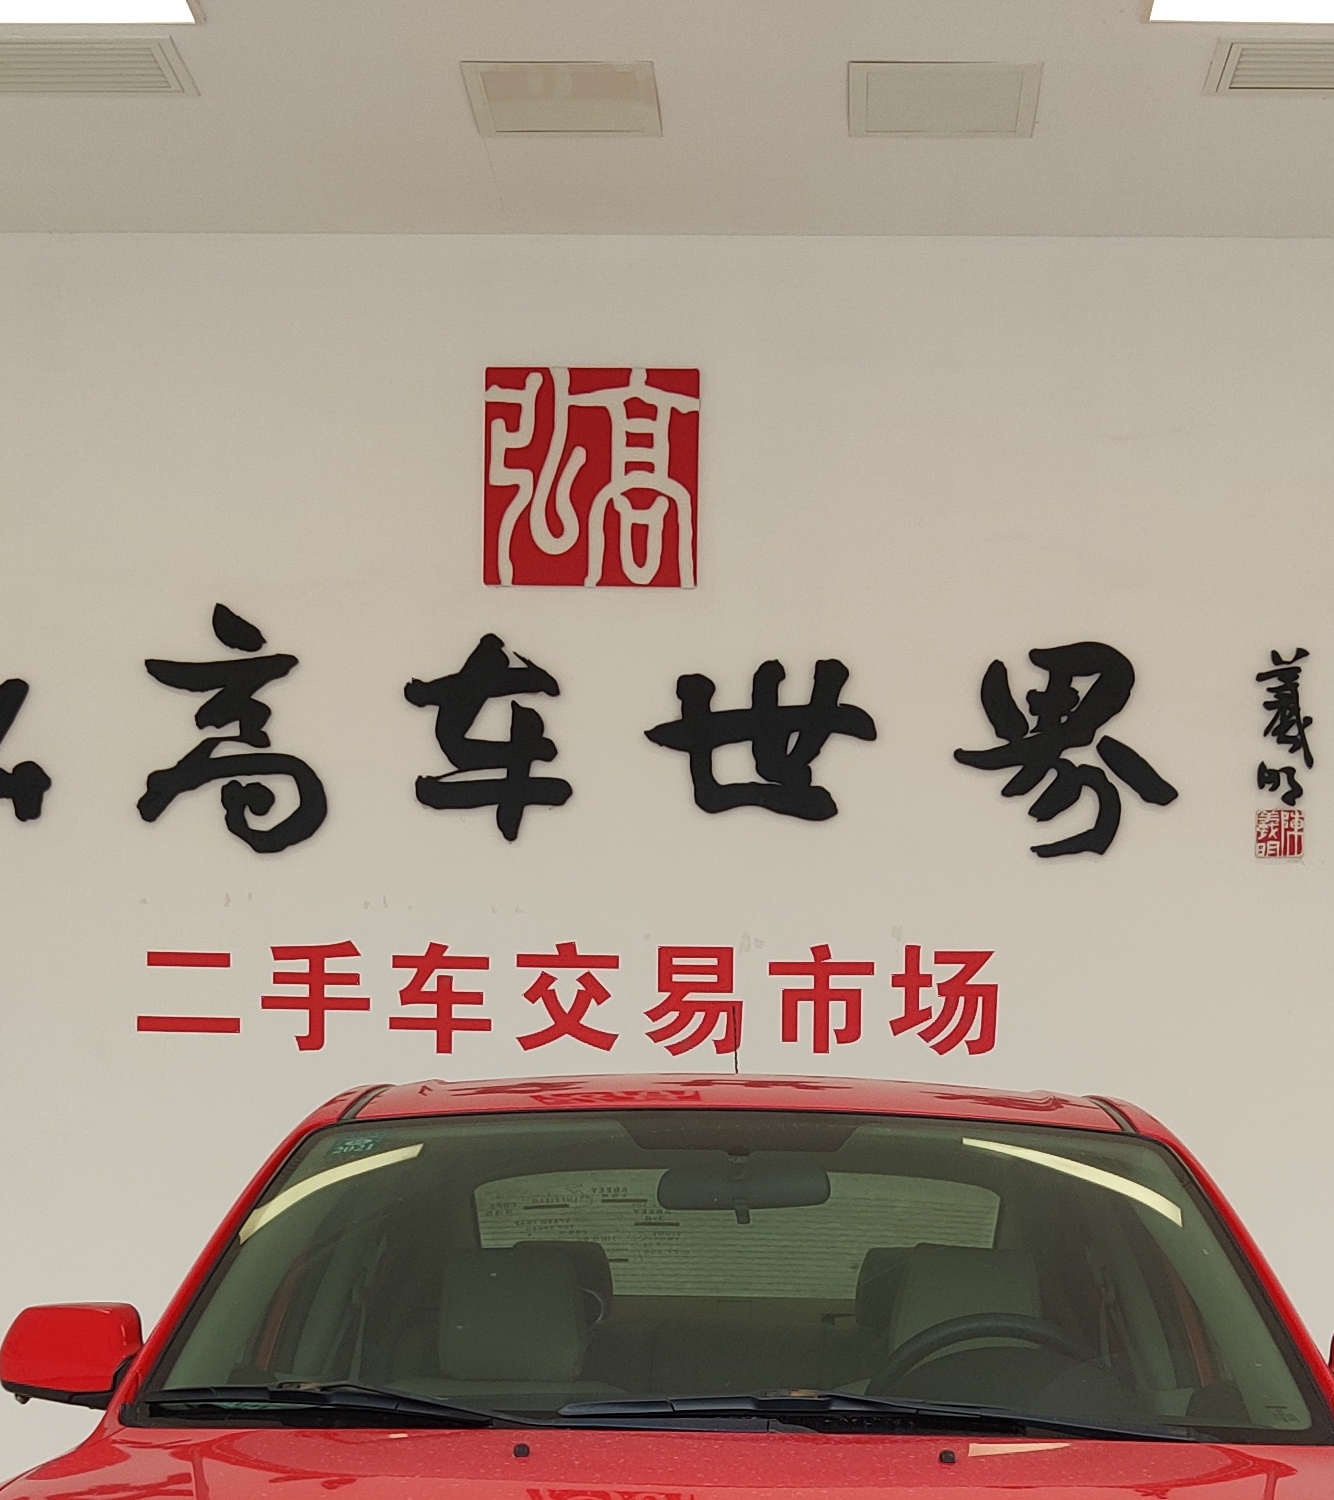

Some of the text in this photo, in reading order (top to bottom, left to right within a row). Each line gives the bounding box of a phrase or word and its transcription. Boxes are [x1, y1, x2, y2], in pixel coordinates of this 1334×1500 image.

[136, 940, 999, 1057] 二手车交易市场
